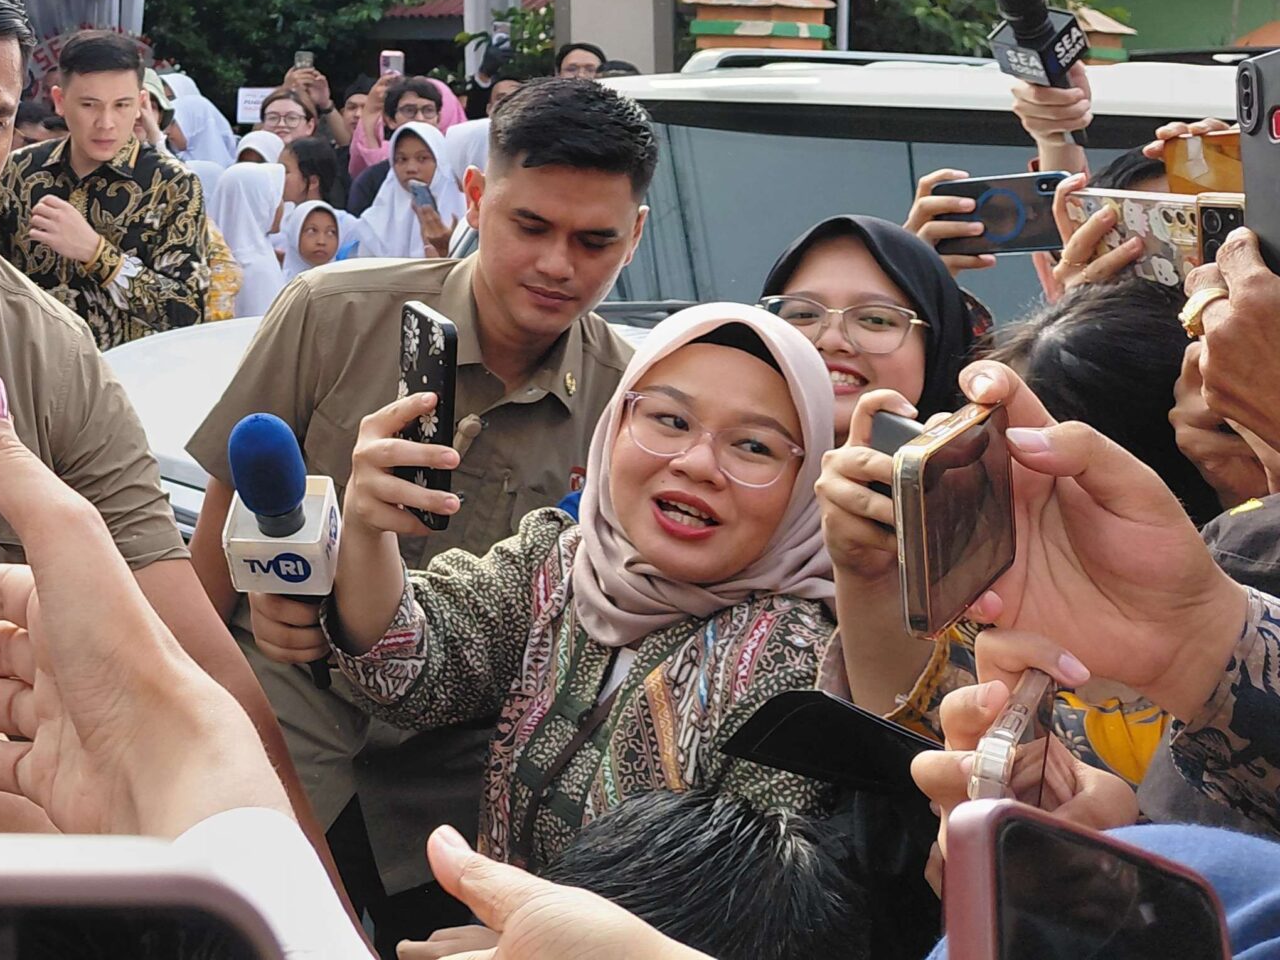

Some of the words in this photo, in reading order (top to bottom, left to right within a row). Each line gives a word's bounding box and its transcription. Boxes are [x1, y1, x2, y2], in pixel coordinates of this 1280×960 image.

[1054, 27, 1082, 58] SEA
[1006, 49, 1044, 71] SEA
[243, 558, 306, 576] TVRI
